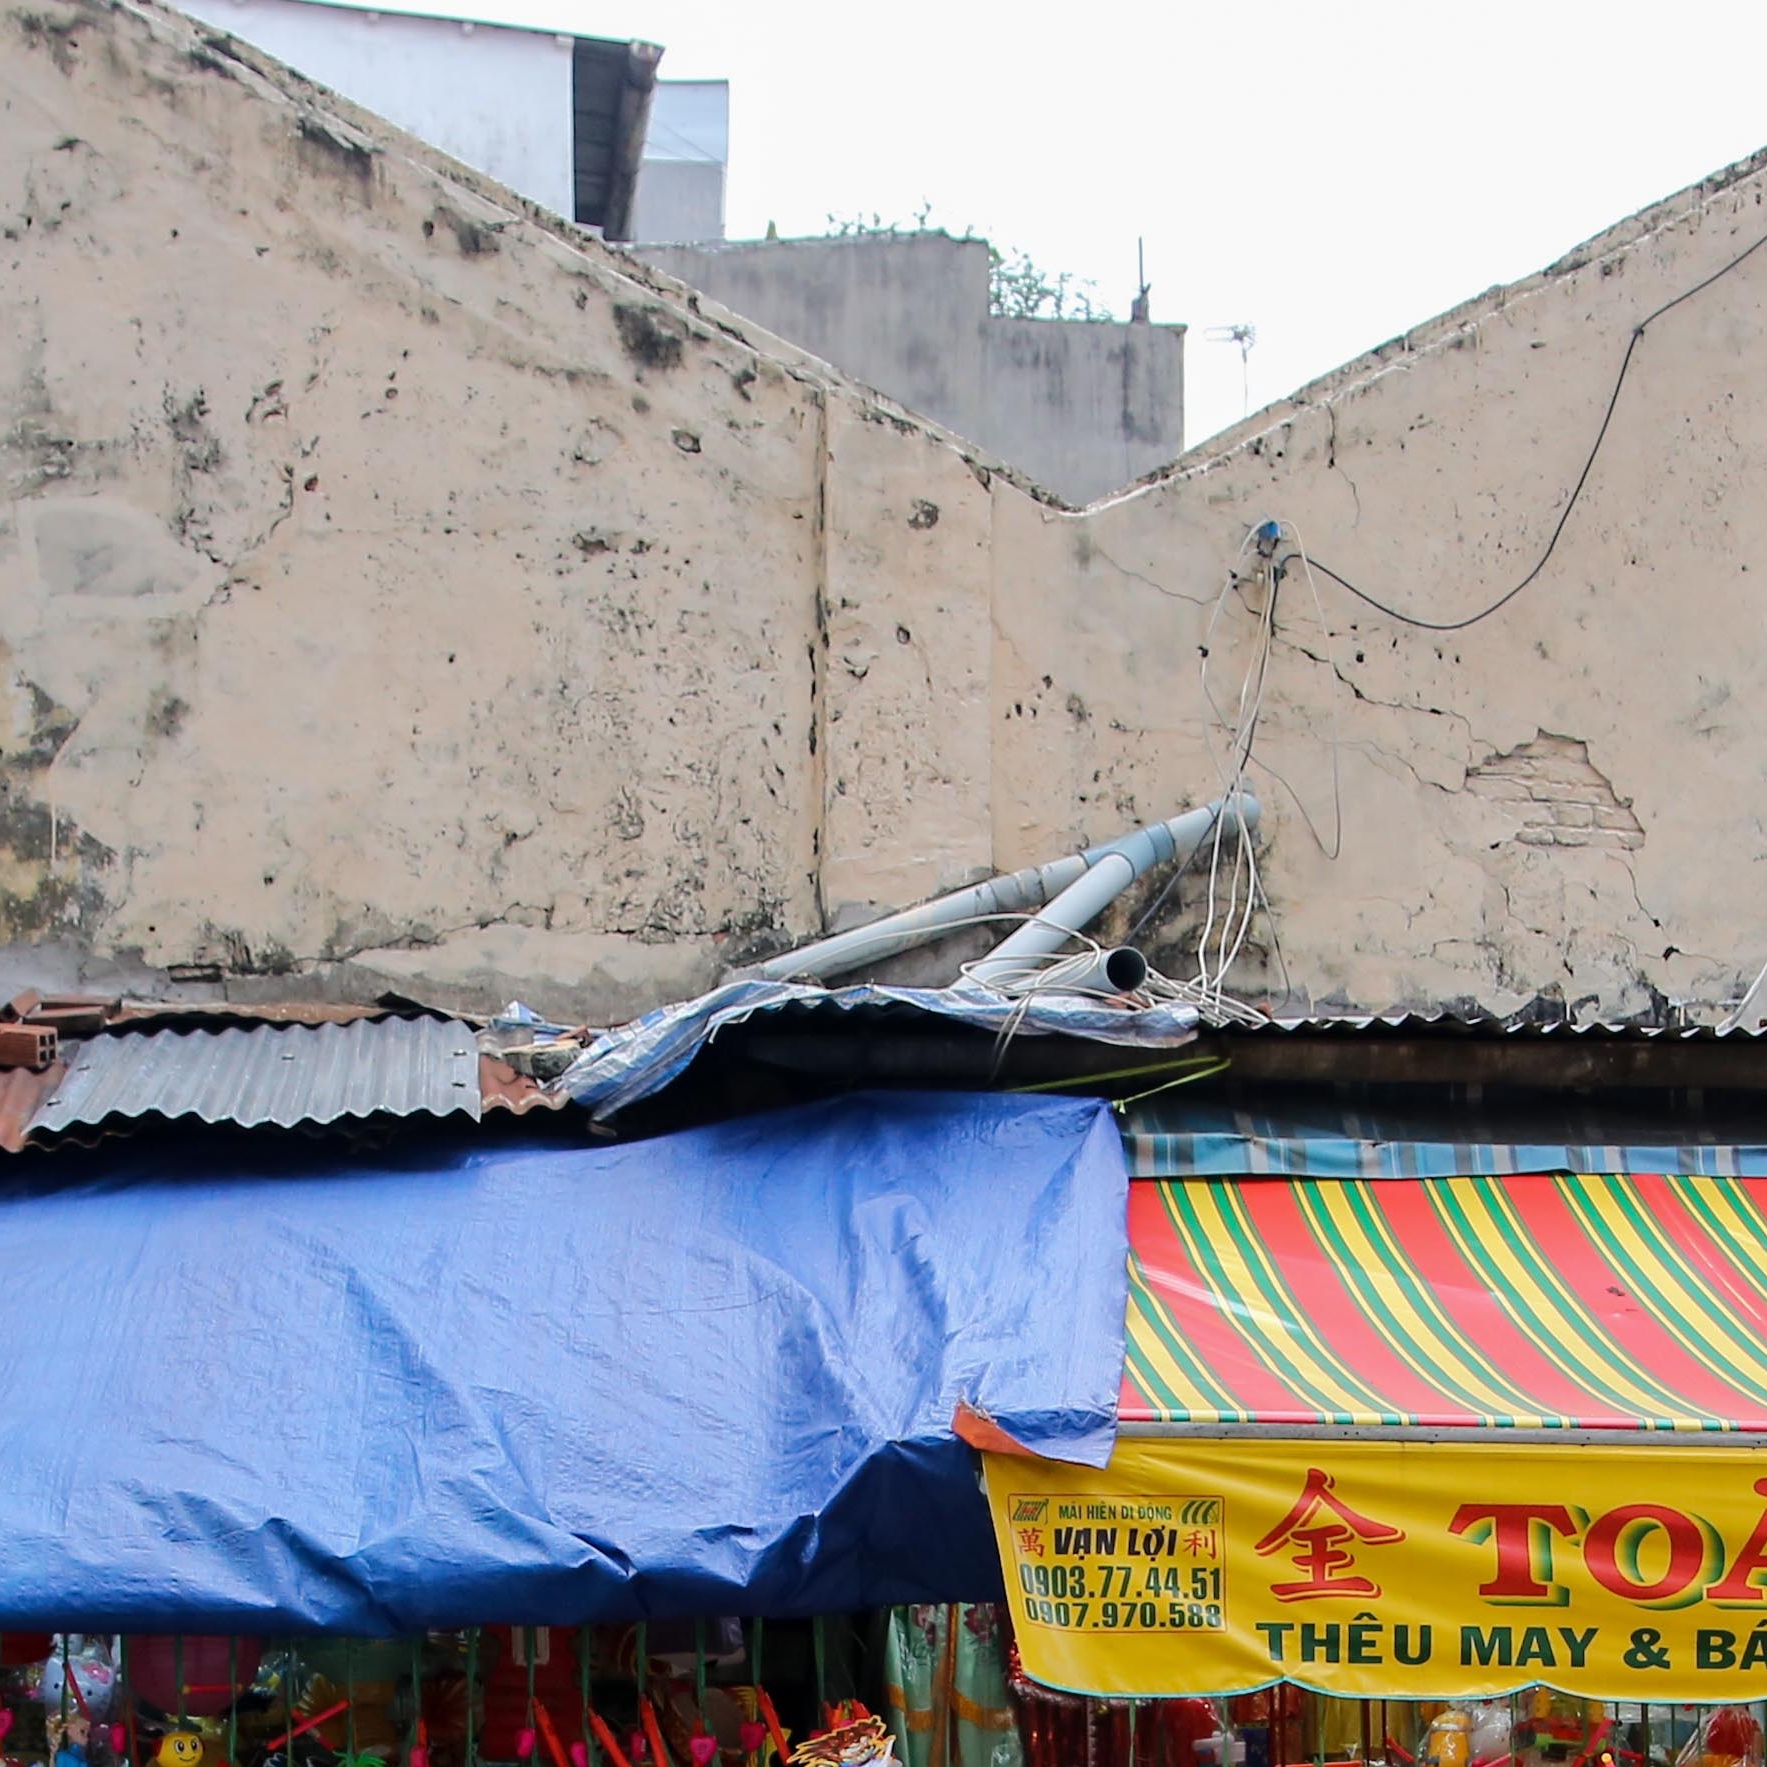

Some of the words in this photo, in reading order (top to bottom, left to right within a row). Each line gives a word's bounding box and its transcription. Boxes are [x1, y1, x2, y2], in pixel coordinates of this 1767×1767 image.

[1121, 1505, 1134, 1520] DI
[1017, 1528, 1045, 1558] 萬
[1054, 1527, 1118, 1560] VẠN
[1127, 1525, 1178, 1561] LỢI
[1183, 1529, 1217, 1560] 利
[1254, 1467, 1407, 1602] 全
[1019, 1563, 1221, 1600] 0903.77.44.51
[1025, 1598, 1222, 1628] 0907.970.588
[1256, 1612, 1432, 1665] THÊU
[1461, 1626, 1599, 1668] MAY
[1624, 1628, 1670, 1670] &
